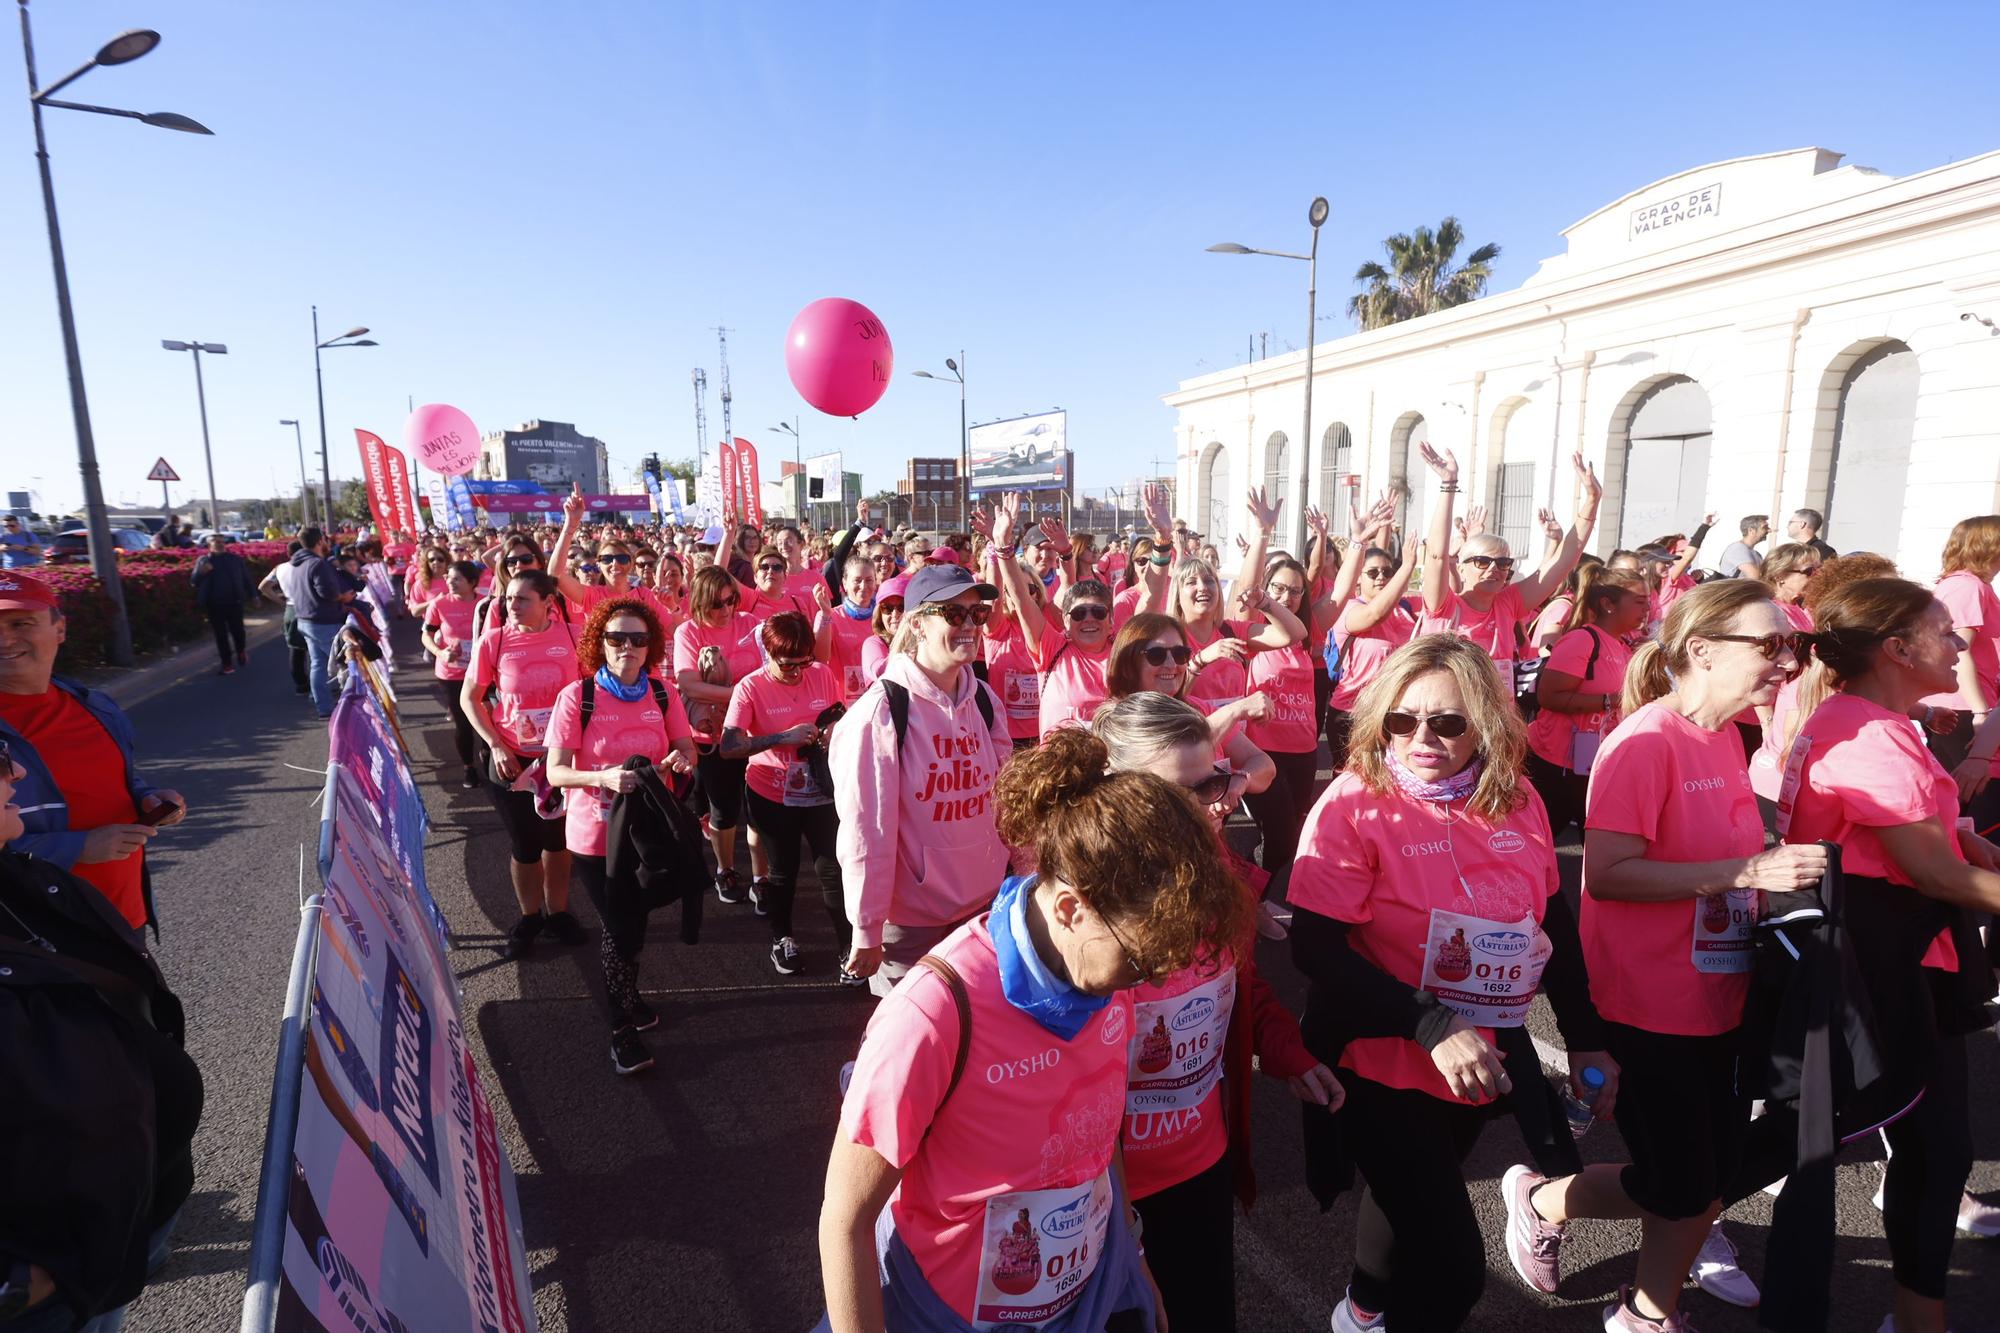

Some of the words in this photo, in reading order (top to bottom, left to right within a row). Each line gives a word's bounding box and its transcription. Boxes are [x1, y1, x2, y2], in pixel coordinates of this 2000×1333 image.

[1638, 201, 1680, 222] GRAO
[1689, 190, 1712, 206] DE
[1634, 203, 1713, 234] VALENCIA
[421, 431, 462, 458] JUNTAS
[437, 451, 478, 473] MEJOR
[441, 449, 458, 462] ES
[1268, 674, 1284, 688] TU
[1268, 692, 1313, 705] DORSAL
[1066, 705, 1086, 720] TU
[915, 760, 990, 801] jolie,
[1684, 776, 1725, 792] OYSHO
[933, 791, 992, 822] mer
[1402, 840, 1452, 857] OYSHO
[1477, 938, 1528, 951] ASTURIANA
[1703, 956, 1737, 966] OYSHO
[1475, 963, 1522, 979] 016
[1482, 982, 1511, 993] 1692
[1438, 990, 1478, 1002] CARRERA
[1478, 996, 1490, 1004] DE
[1174, 1005, 1214, 1027] ASTURIANA
[1175, 1031, 1209, 1060] 016
[392, 968, 427, 1161] Norauto
[986, 1048, 1061, 1085] OYSHO
[1181, 1055, 1202, 1073] 1691
[1140, 1080, 1178, 1089] CARRERA
[1179, 1077, 1190, 1087] DE
[1190, 1073, 1199, 1083] LA
[1134, 1095, 1177, 1105] OYSHO
[1130, 1103, 1202, 1140] UMA
[461, 1137, 474, 1156] a
[1054, 1269, 1082, 1294] 1690
[998, 1307, 1048, 1320] CARRERA
[1050, 1302, 1060, 1313] DE
[1061, 1294, 1072, 1307] LA
